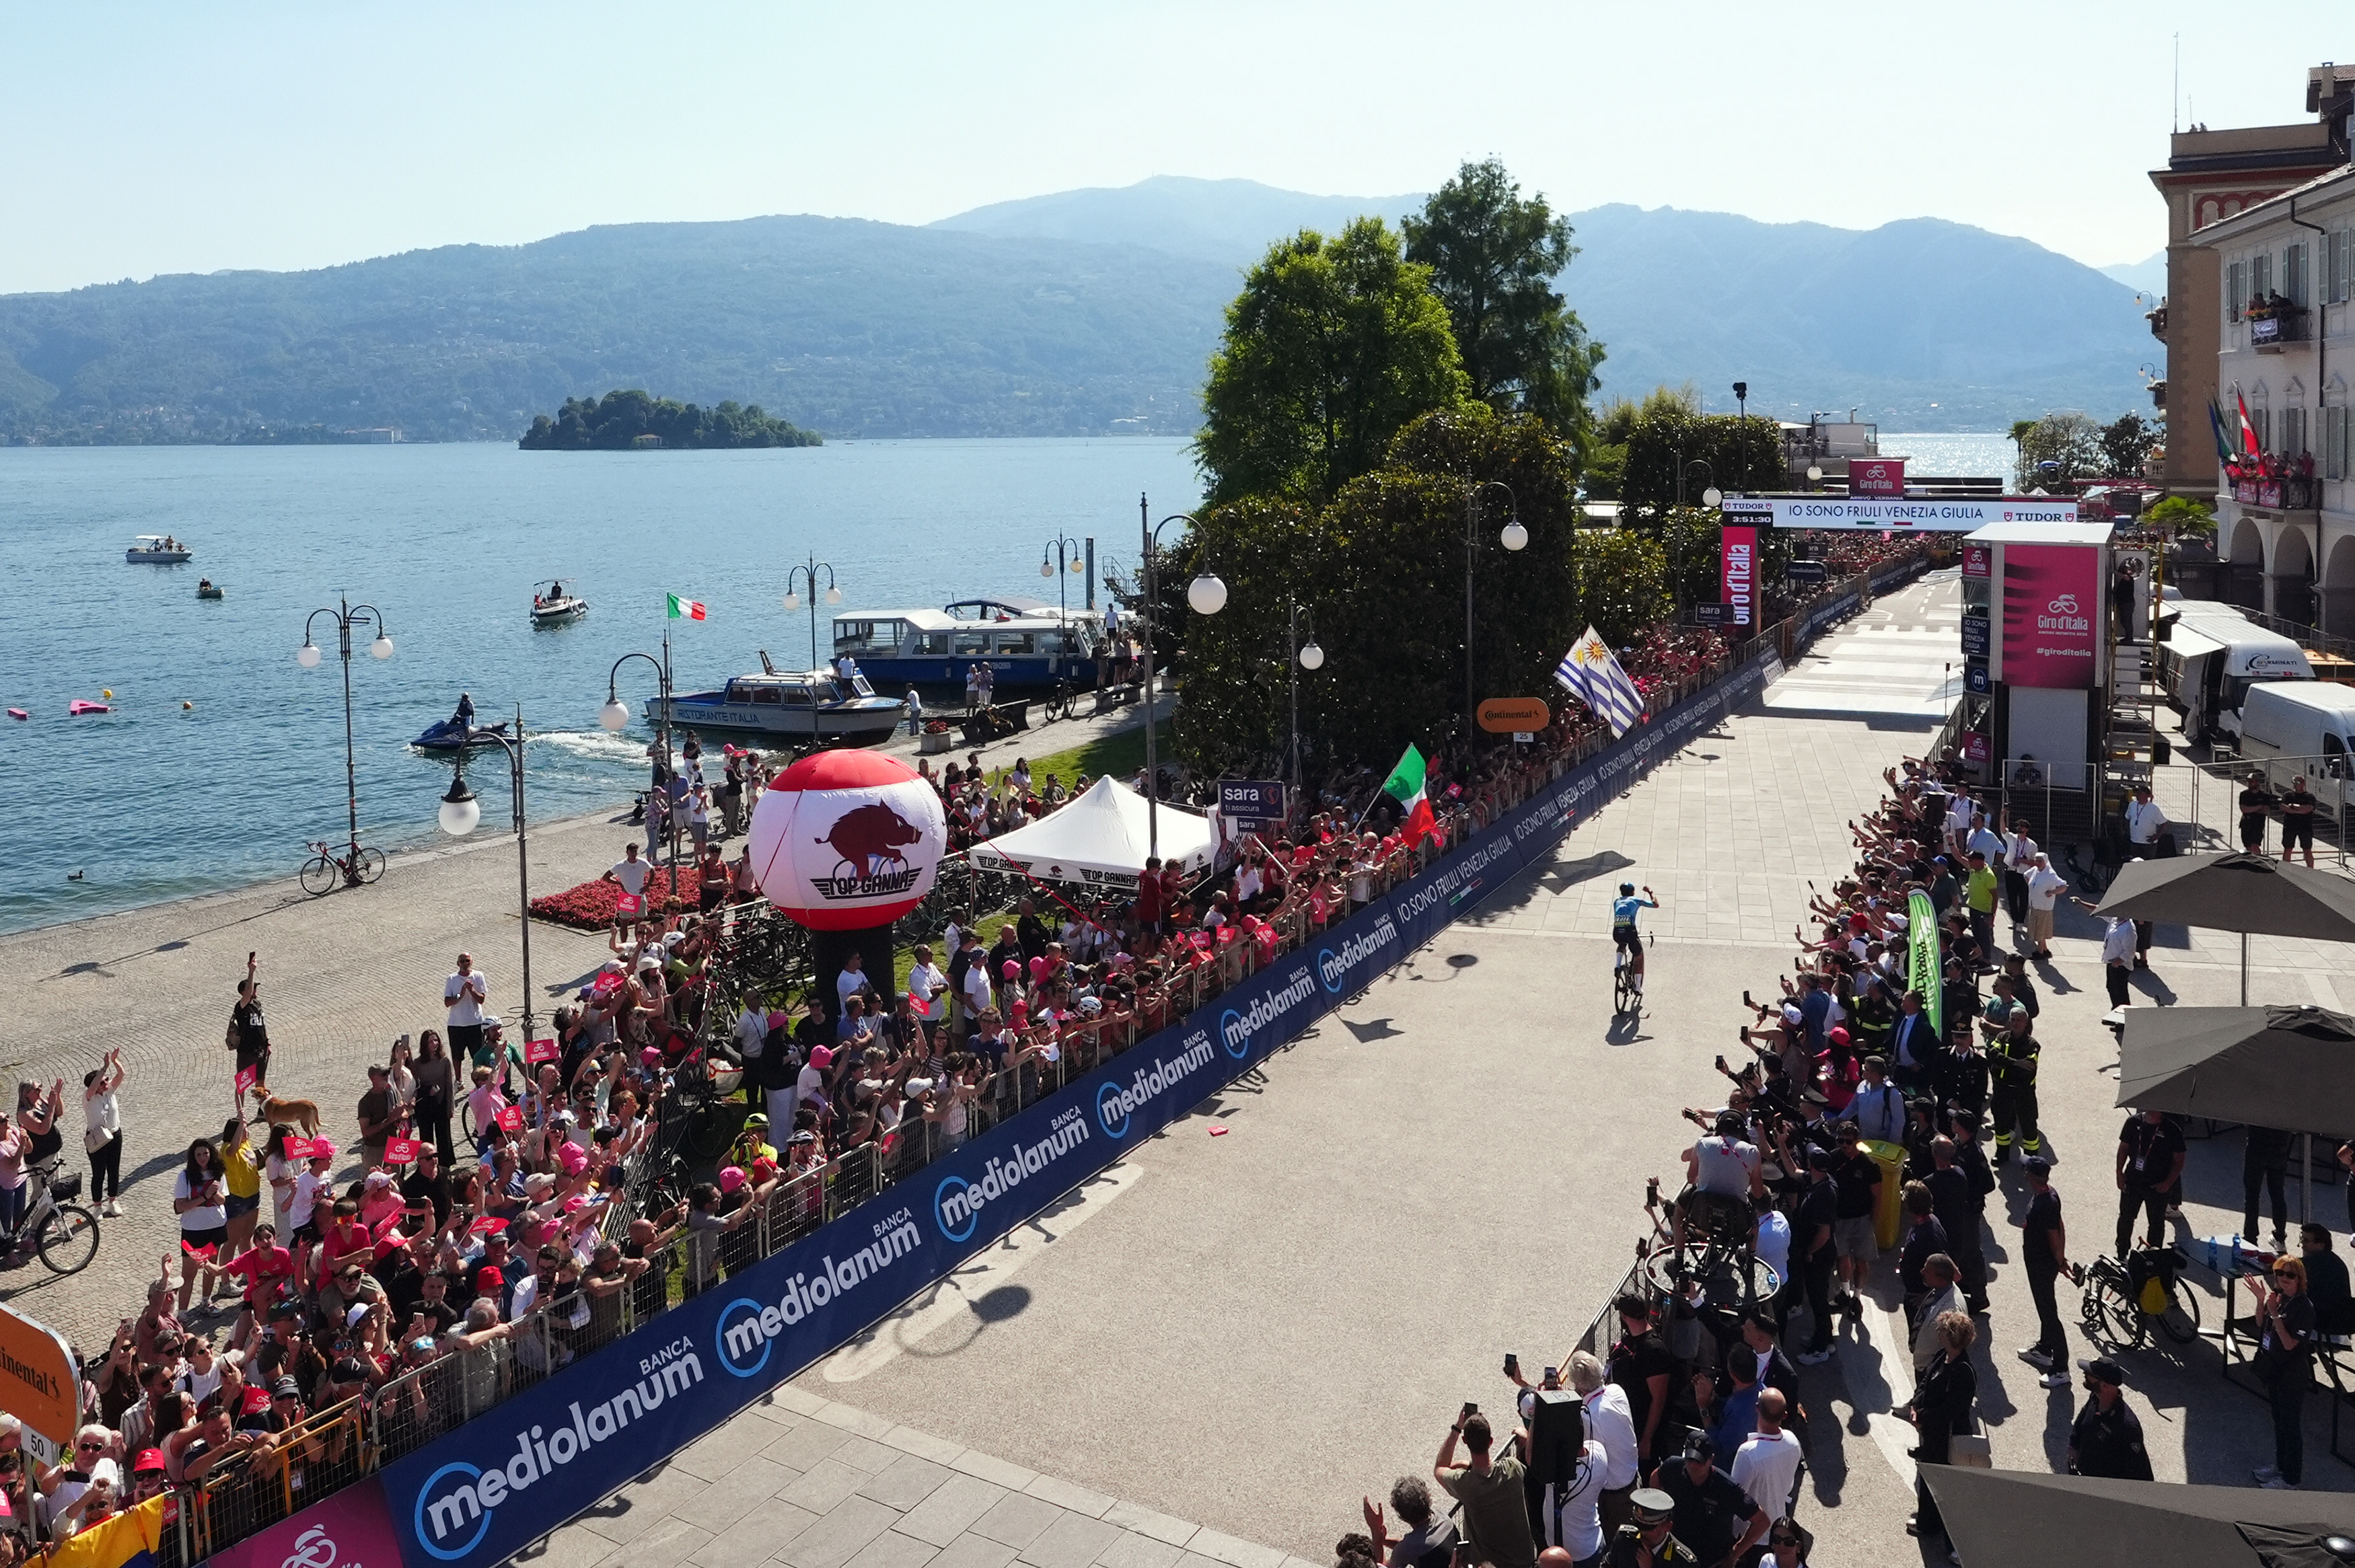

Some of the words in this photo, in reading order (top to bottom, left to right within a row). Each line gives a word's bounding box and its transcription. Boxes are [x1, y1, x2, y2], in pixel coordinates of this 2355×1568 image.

[1860, 480, 1873, 489] Giro
[1873, 480, 1893, 489] d'Italia
[1789, 505, 1802, 516] IO
[1806, 505, 1843, 517] SONO
[1848, 506, 1881, 517] FRIULI
[1885, 507, 1938, 518] VENEZIA
[1941, 507, 1983, 519] GIULIA
[2016, 513, 2062, 521] TUDOR
[1727, 544, 1750, 593] d'Italia
[1699, 605, 1720, 614] sara
[1971, 620, 1987, 628] SONO
[2038, 615, 2057, 628] Giro
[2058, 616, 2088, 630] d'Italia
[2037, 647, 2091, 657] #giroditalia
[678, 709, 729, 720] RISTORANTE
[729, 712, 760, 723] ITALIA
[1485, 710, 1532, 720] Continental
[1671, 715, 1683, 733] SONO
[1693, 699, 1709, 718] VENEZIA
[1598, 768, 1607, 780] IO
[1606, 758, 1622, 776] SONO
[1620, 749, 1634, 768] FRIULI
[1632, 737, 1652, 756] VENEZIA
[1650, 729, 1665, 746] GIULIA
[1225, 788, 1259, 801] sara
[1514, 827, 1525, 842] IO
[1523, 811, 1544, 835] SONO
[1542, 800, 1558, 821] FRIULI
[1556, 785, 1581, 812] VENEZIA
[1579, 775, 1599, 796] GIULIA
[984, 856, 999, 867] TOP
[999, 859, 1025, 871] GANNA
[829, 876, 857, 895] TOP
[861, 871, 908, 893] GANNA
[1087, 870, 1103, 881] TOP
[1104, 872, 1132, 885] GANNA
[1397, 903, 1411, 924] IO
[1410, 885, 1437, 916] SONO
[1436, 868, 1461, 897] FRIULI
[1457, 849, 1491, 880] VENEZIA
[1488, 834, 1513, 860] GIULIA
[1374, 913, 1391, 928] BANCA
[1322, 922, 1397, 982] mediolanum
[1289, 965, 1309, 982] BANCA
[1225, 975, 1315, 1047] mediolanum
[1183, 1029, 1207, 1049] BANCA
[1101, 1040, 1215, 1125] mediolanum
[1050, 1105, 1082, 1130] BANCA
[941, 1118, 1089, 1228] mediolanum
[873, 1207, 912, 1238] BANCA
[724, 1221, 921, 1360] mediolanum
[639, 1335, 694, 1376] BANCA
[0, 1346, 48, 1396] inental
[31, 1433, 44, 1457] 50
[427, 1351, 704, 1540] mediolanum
